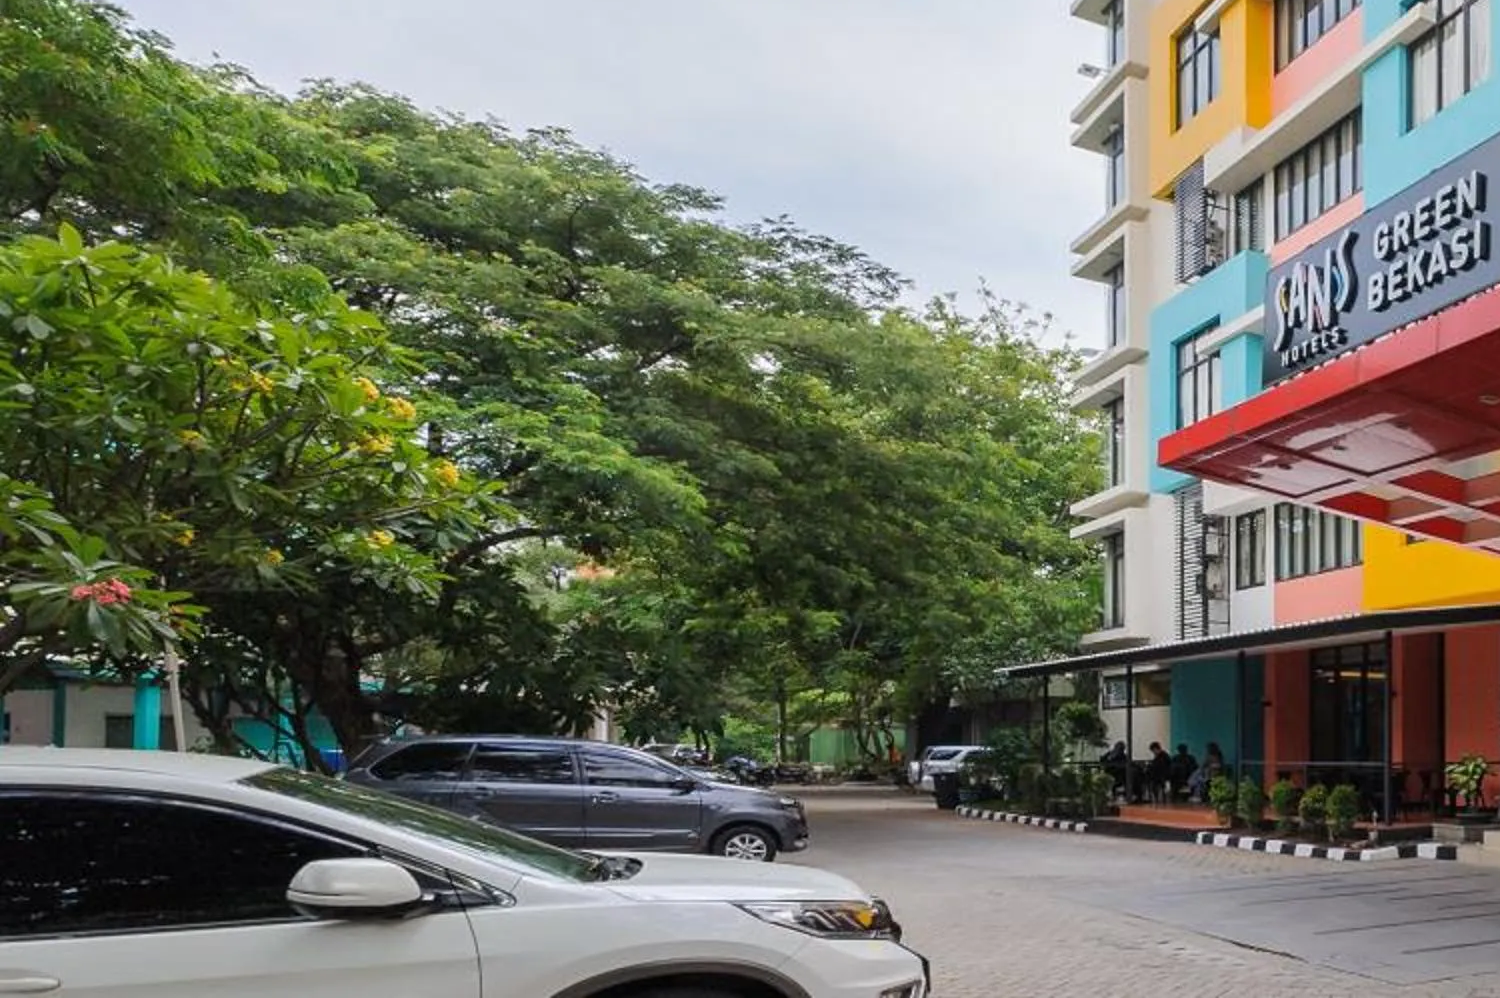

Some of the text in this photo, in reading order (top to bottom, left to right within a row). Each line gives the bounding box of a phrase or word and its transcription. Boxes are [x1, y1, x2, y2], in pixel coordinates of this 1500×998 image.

[1373, 170, 1482, 258] GREEN
[1273, 228, 1353, 352] SANS
[1367, 220, 1484, 311] BEKASI
[1281, 325, 1342, 366] HOTELS
